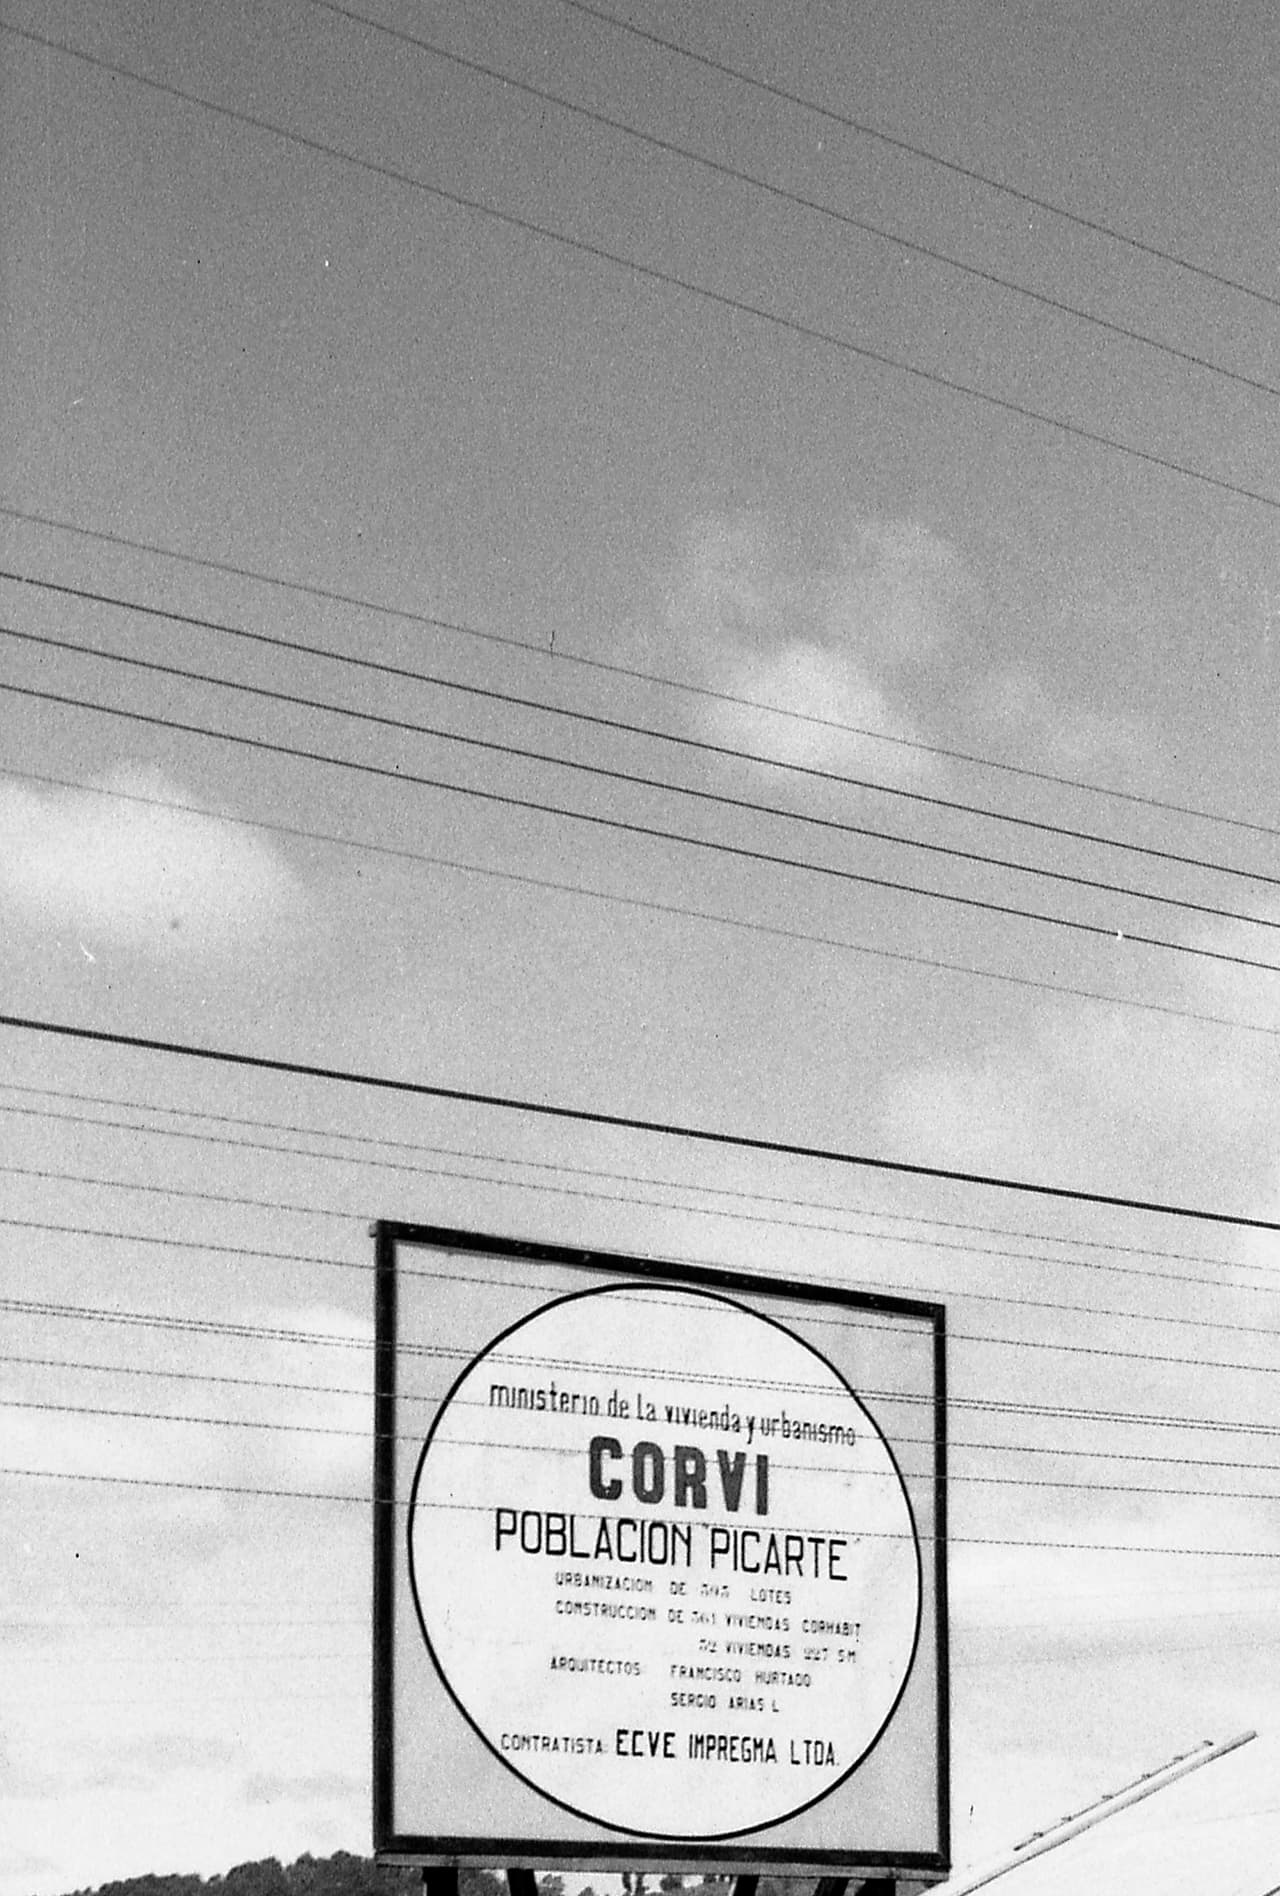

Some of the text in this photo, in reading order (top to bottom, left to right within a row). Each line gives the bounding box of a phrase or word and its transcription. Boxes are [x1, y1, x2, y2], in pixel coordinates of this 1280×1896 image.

[489, 1381, 599, 1416] ministerio
[607, 1389, 630, 1420] de
[664, 1404, 740, 1434] vivienda
[745, 1414, 756, 1445] y
[760, 1410, 856, 1447] urbanismo
[589, 1435, 769, 1516] CORVI
[495, 1508, 848, 1582] POBLACION PICARTE
[555, 1571, 653, 1592] URBANIZACION
[670, 1581, 687, 1596] DE
[751, 1587, 791, 1605] LOTES
[555, 1600, 656, 1621] CONSTRUCCION
[668, 1608, 684, 1624] DE
[725, 1614, 790, 1632] VIVIENDAS
[725, 1642, 790, 1659] VIVIENDAS
[671, 1665, 741, 1683] FRANCISCO
[755, 1671, 812, 1687] HURTADO
[728, 1697, 764, 1712] ARIAS
[616, 1729, 676, 1759] ECVE
